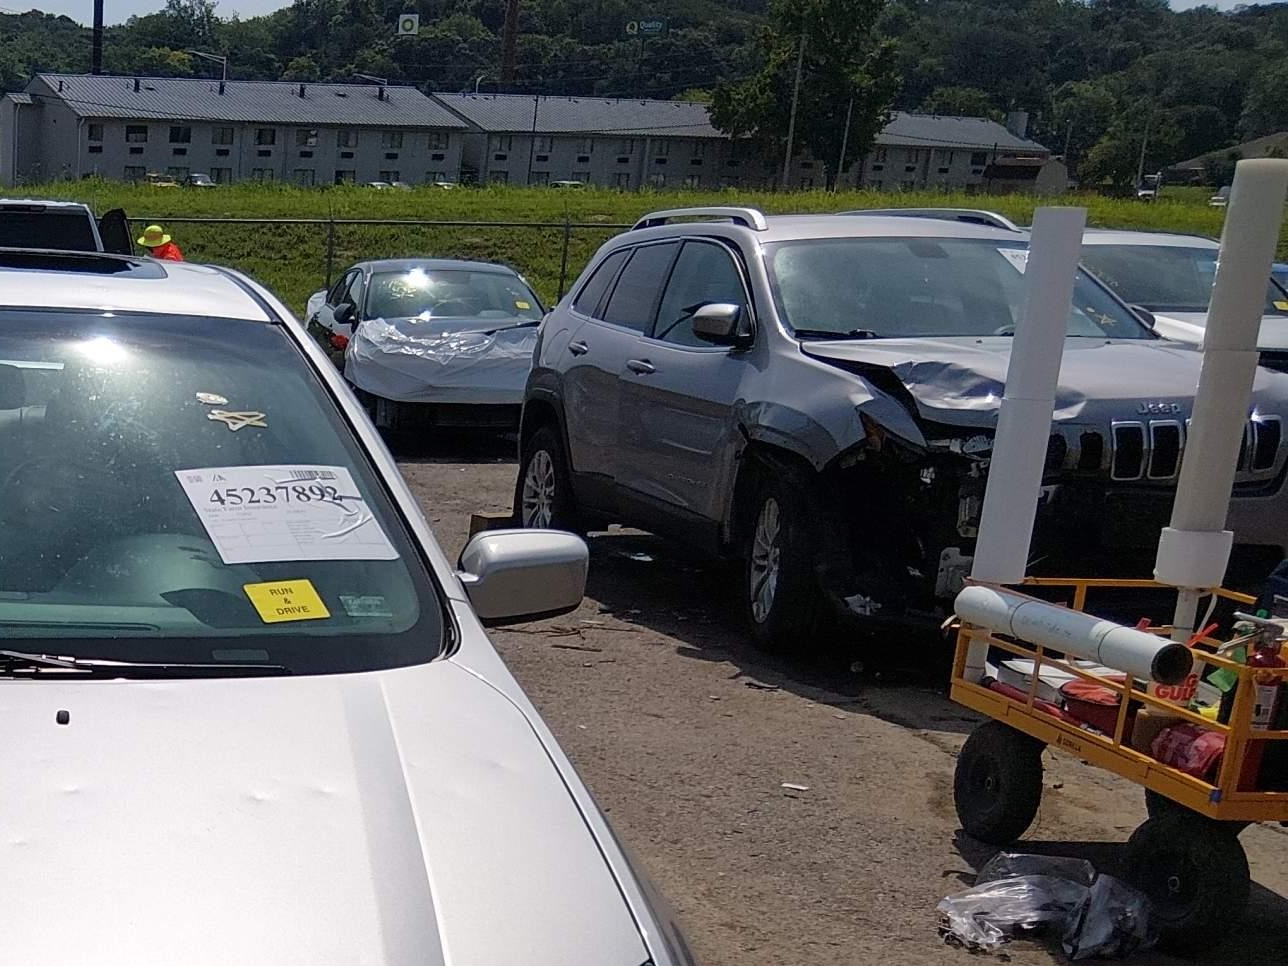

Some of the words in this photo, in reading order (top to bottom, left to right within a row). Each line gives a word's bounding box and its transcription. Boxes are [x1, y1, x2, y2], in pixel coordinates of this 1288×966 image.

[1136, 401, 1182, 415] Jeep
[209, 485, 343, 505] 45237892
[268, 587, 295, 596] RUN
[275, 605, 311, 616] DRIVE
